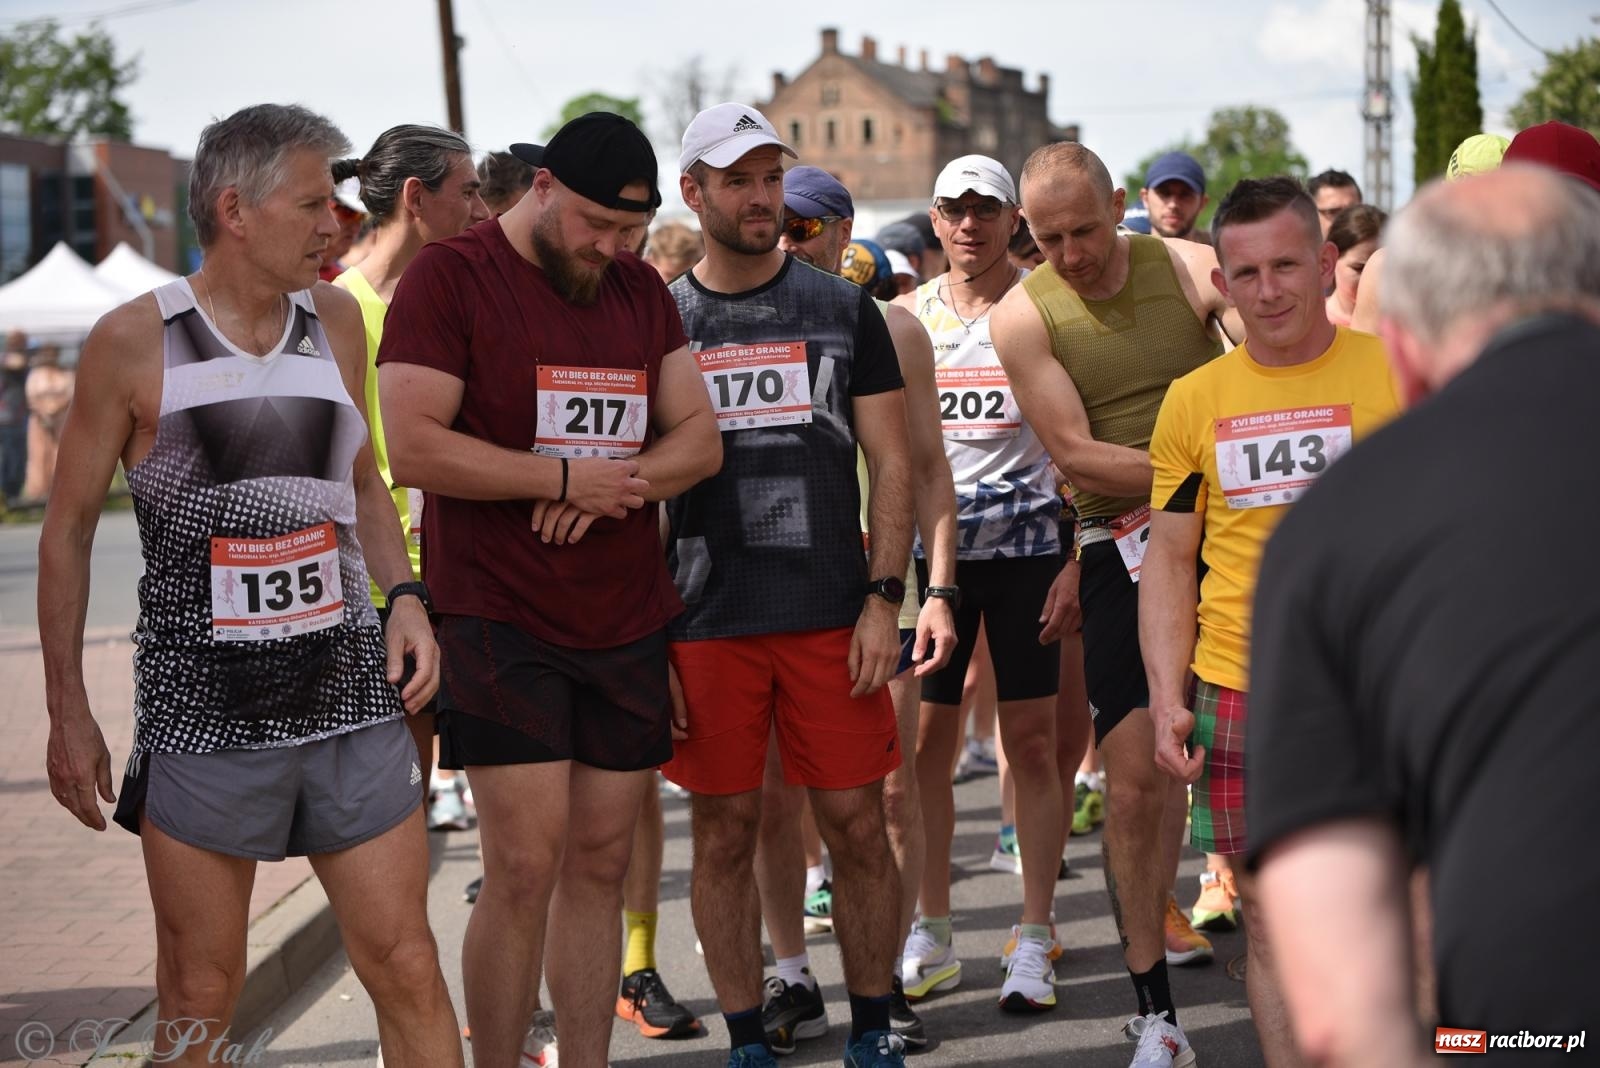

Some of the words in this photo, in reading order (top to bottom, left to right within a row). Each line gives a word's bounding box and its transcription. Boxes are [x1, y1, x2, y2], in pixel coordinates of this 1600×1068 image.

[700, 353, 716, 362] XVI
[716, 350, 737, 359] BIEG
[738, 348, 754, 356] BEZ
[756, 346, 791, 354] GRANIC
[552, 370, 568, 379] XVI
[569, 371, 589, 380] BIEG
[590, 372, 606, 380] BEZ
[607, 372, 636, 382] GRANIC
[713, 369, 784, 408] 170
[565, 396, 627, 436] 217
[940, 390, 1005, 420] 202
[1231, 418, 1249, 428] XVI
[1249, 415, 1273, 426] BIEG
[1273, 412, 1292, 422] BEZ
[1293, 408, 1334, 419] GRANIC
[1242, 434, 1327, 481] 143
[228, 543, 246, 553] XVI
[248, 543, 274, 553] BIEG
[275, 539, 293, 552] BEZ
[293, 529, 326, 546] GRANIC
[241, 561, 323, 613] 135
